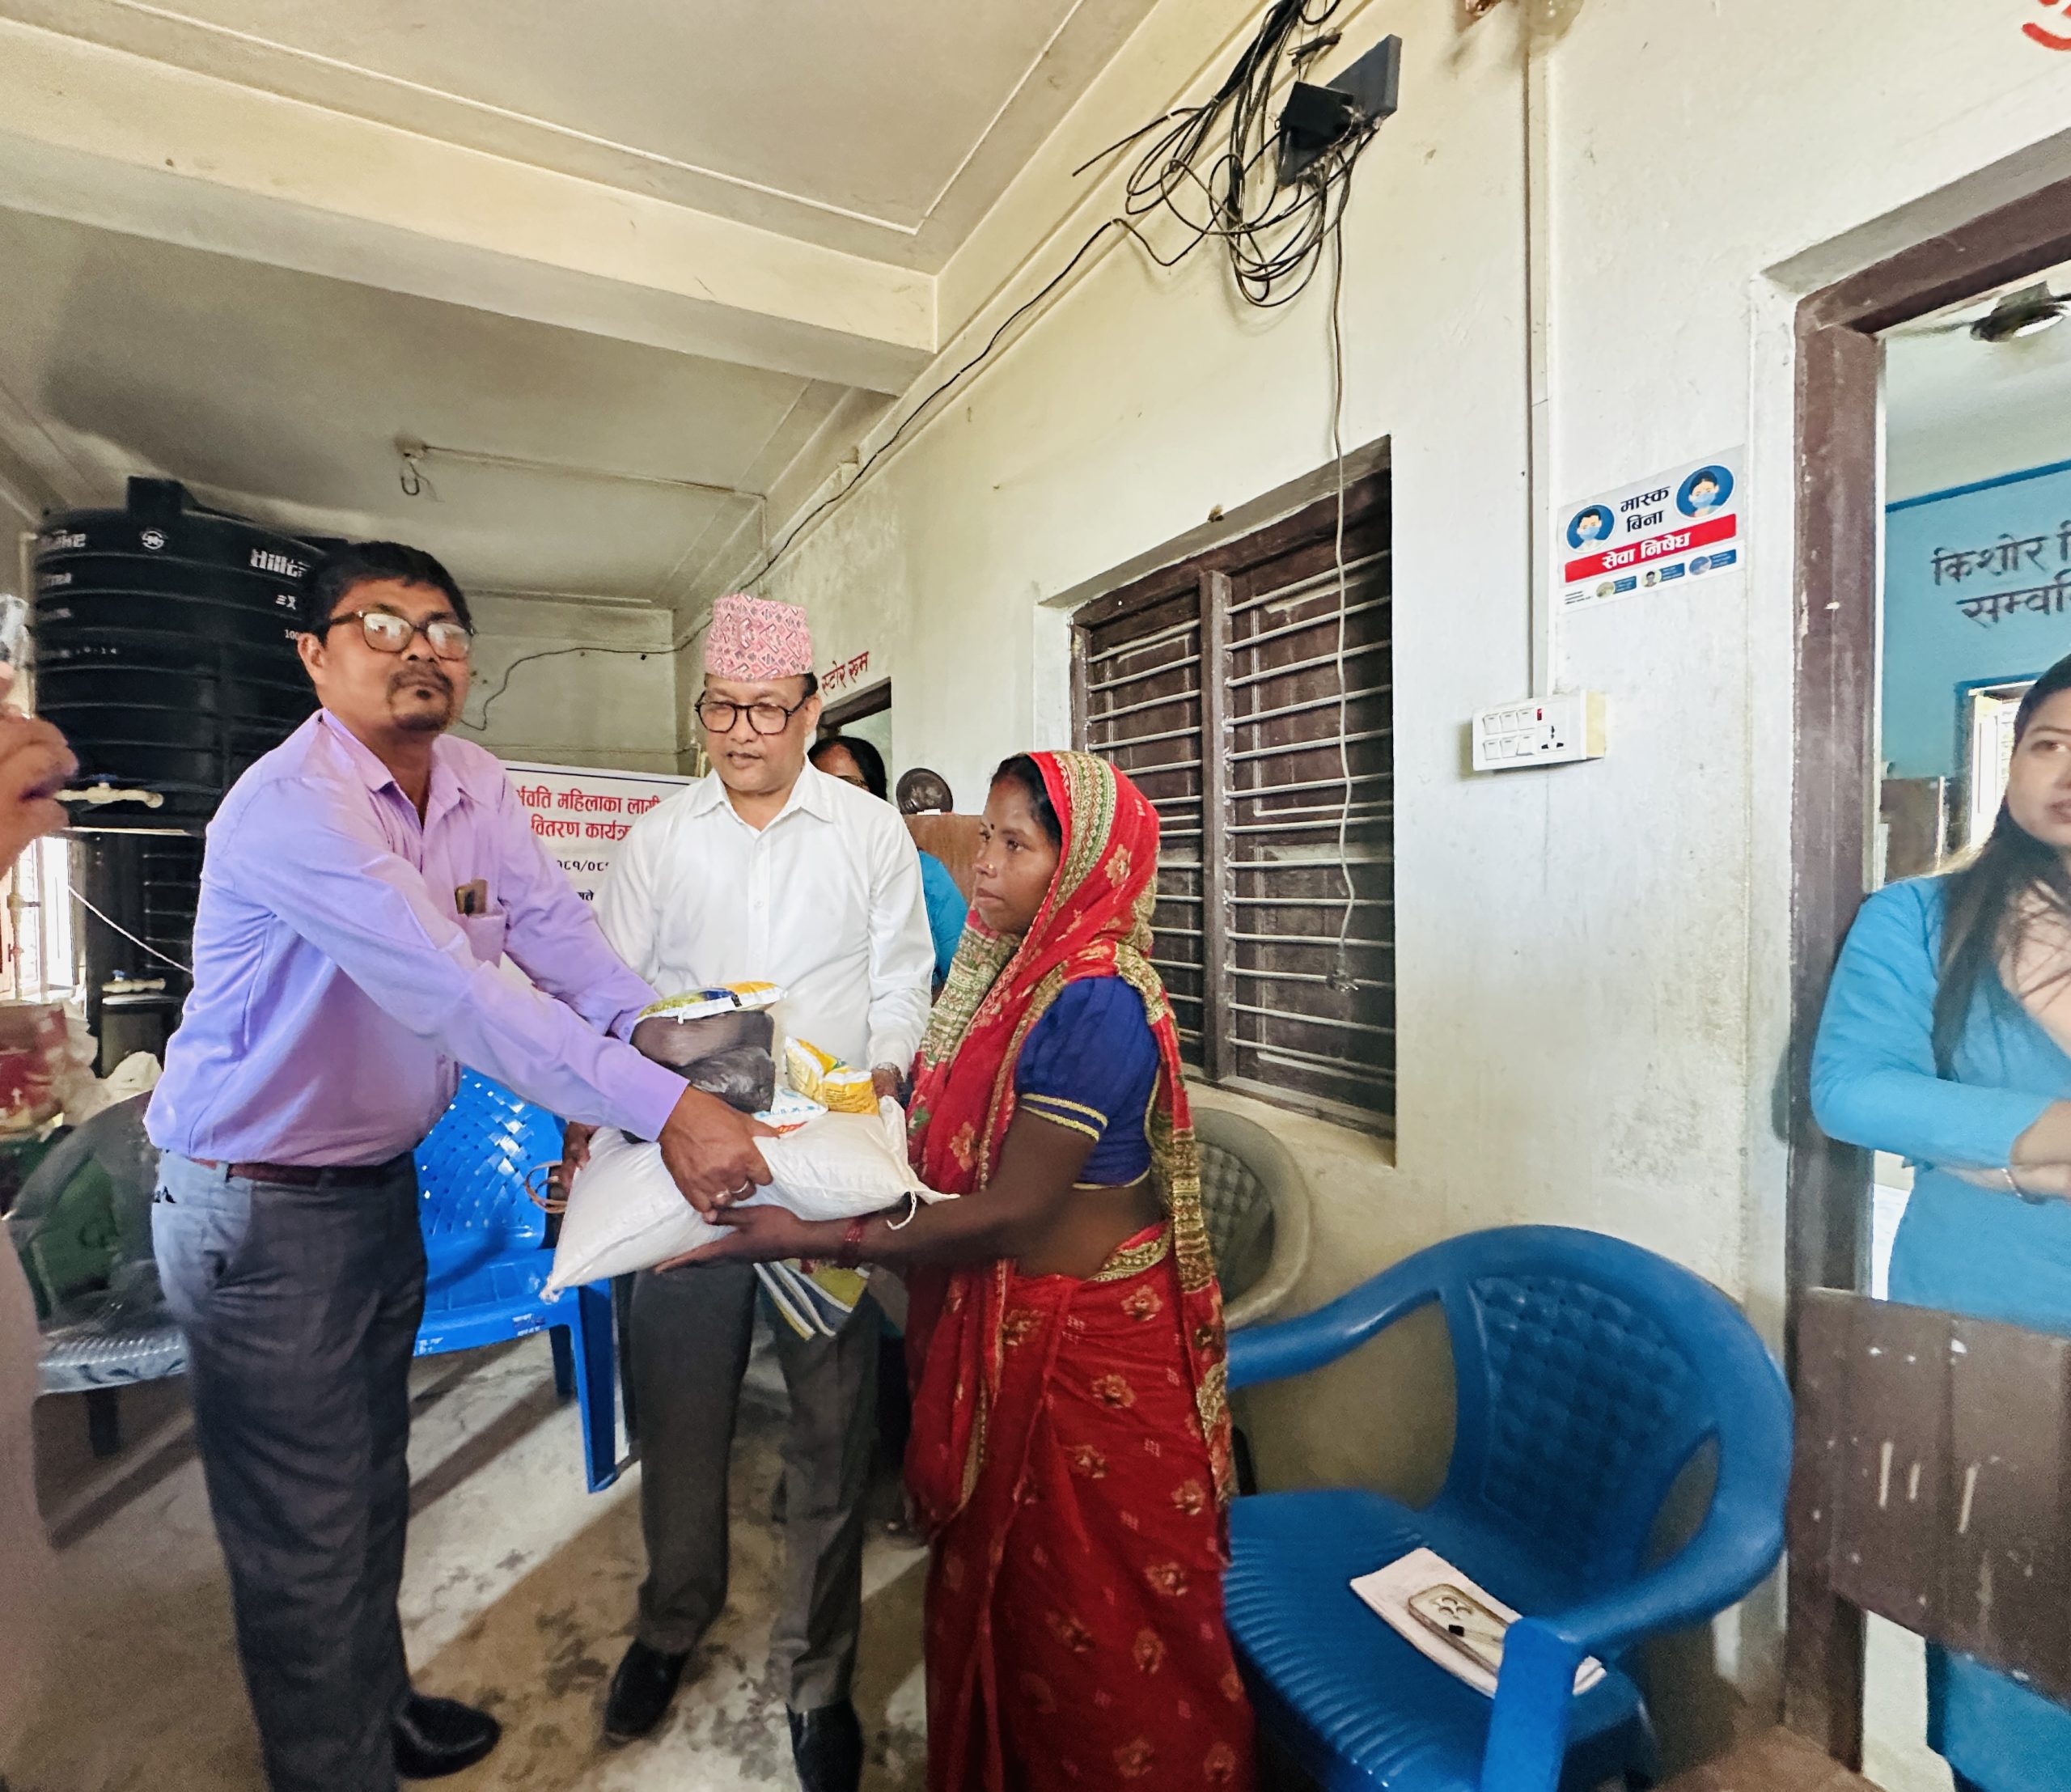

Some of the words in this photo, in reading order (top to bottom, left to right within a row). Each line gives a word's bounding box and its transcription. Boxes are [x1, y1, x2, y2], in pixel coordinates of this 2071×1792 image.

[1620, 485, 1671, 513] मास्क
[1627, 510, 1664, 532] बिना
[1602, 548, 1636, 570] सेवा
[557, 788, 623, 814] महिलाका
